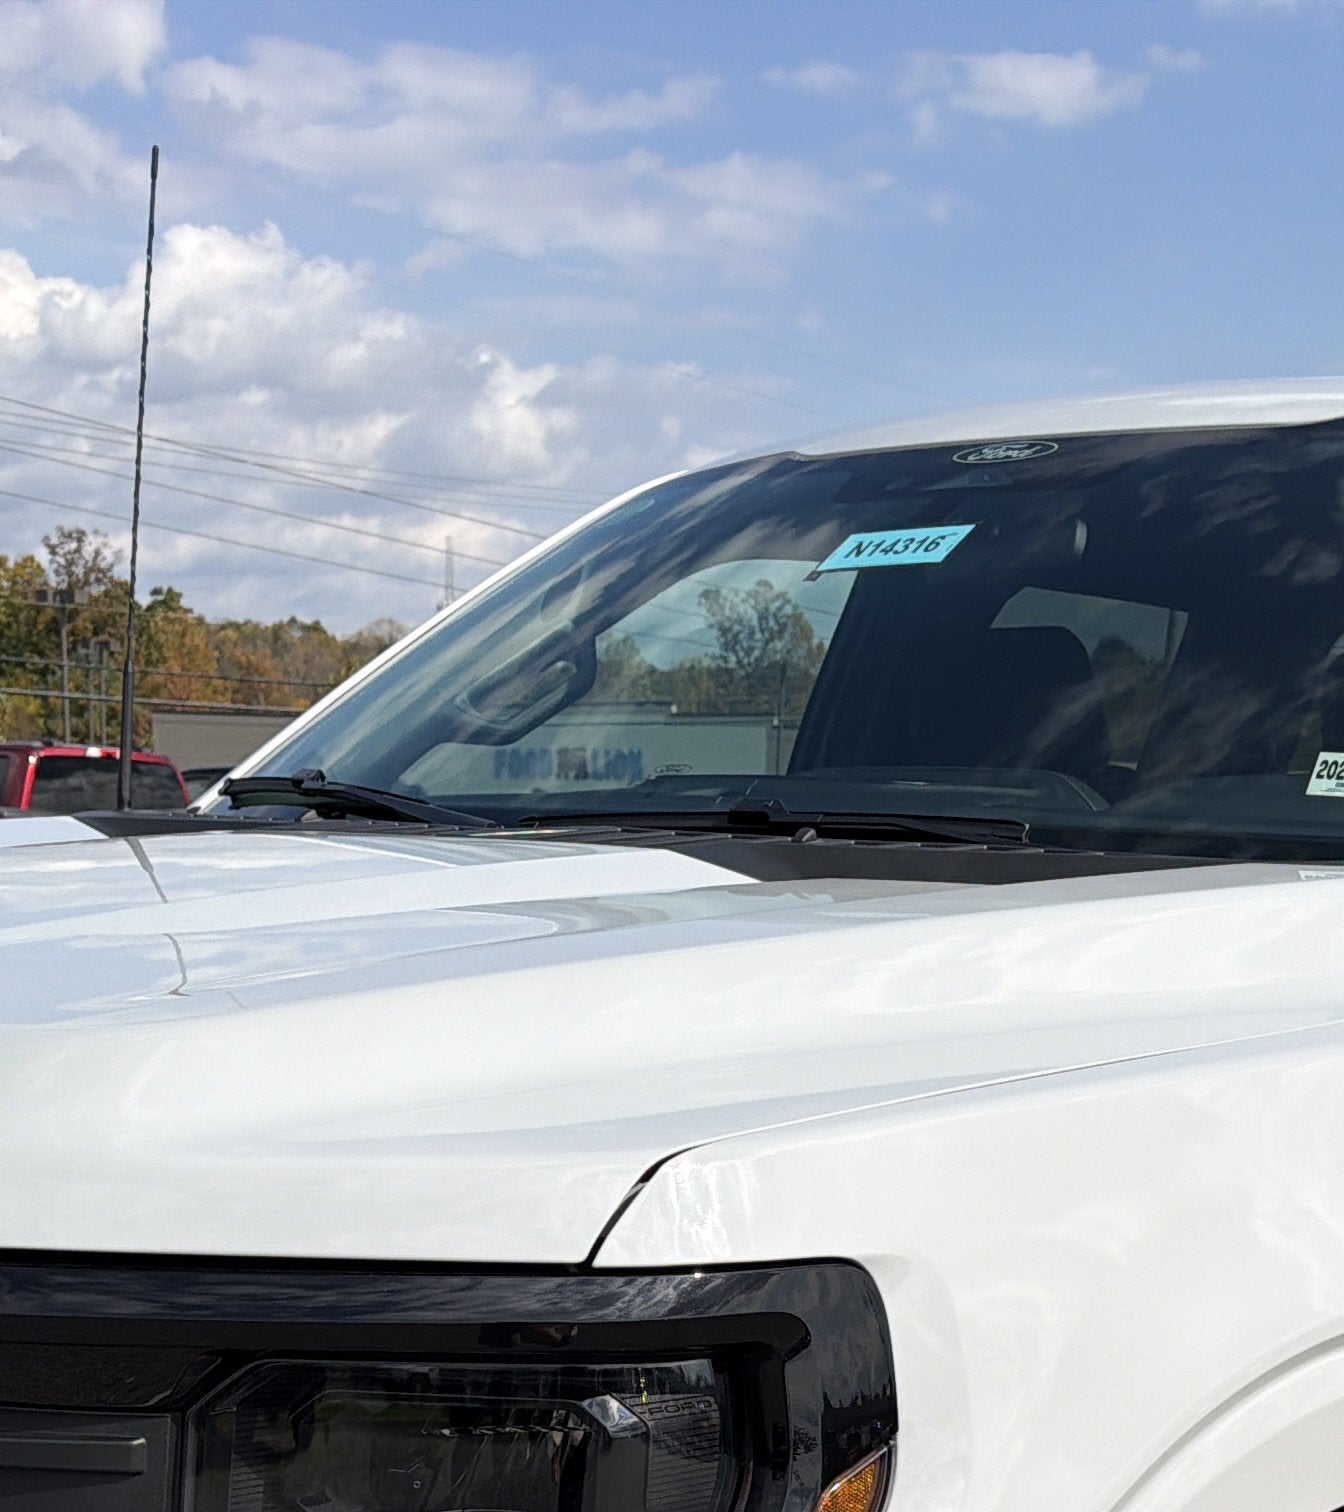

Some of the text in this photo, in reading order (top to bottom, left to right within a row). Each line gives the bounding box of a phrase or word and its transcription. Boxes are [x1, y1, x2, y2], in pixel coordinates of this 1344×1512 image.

[966, 443, 1043, 461] Ford
[843, 534, 947, 559] N14316
[647, 1400, 713, 1416] FORD
